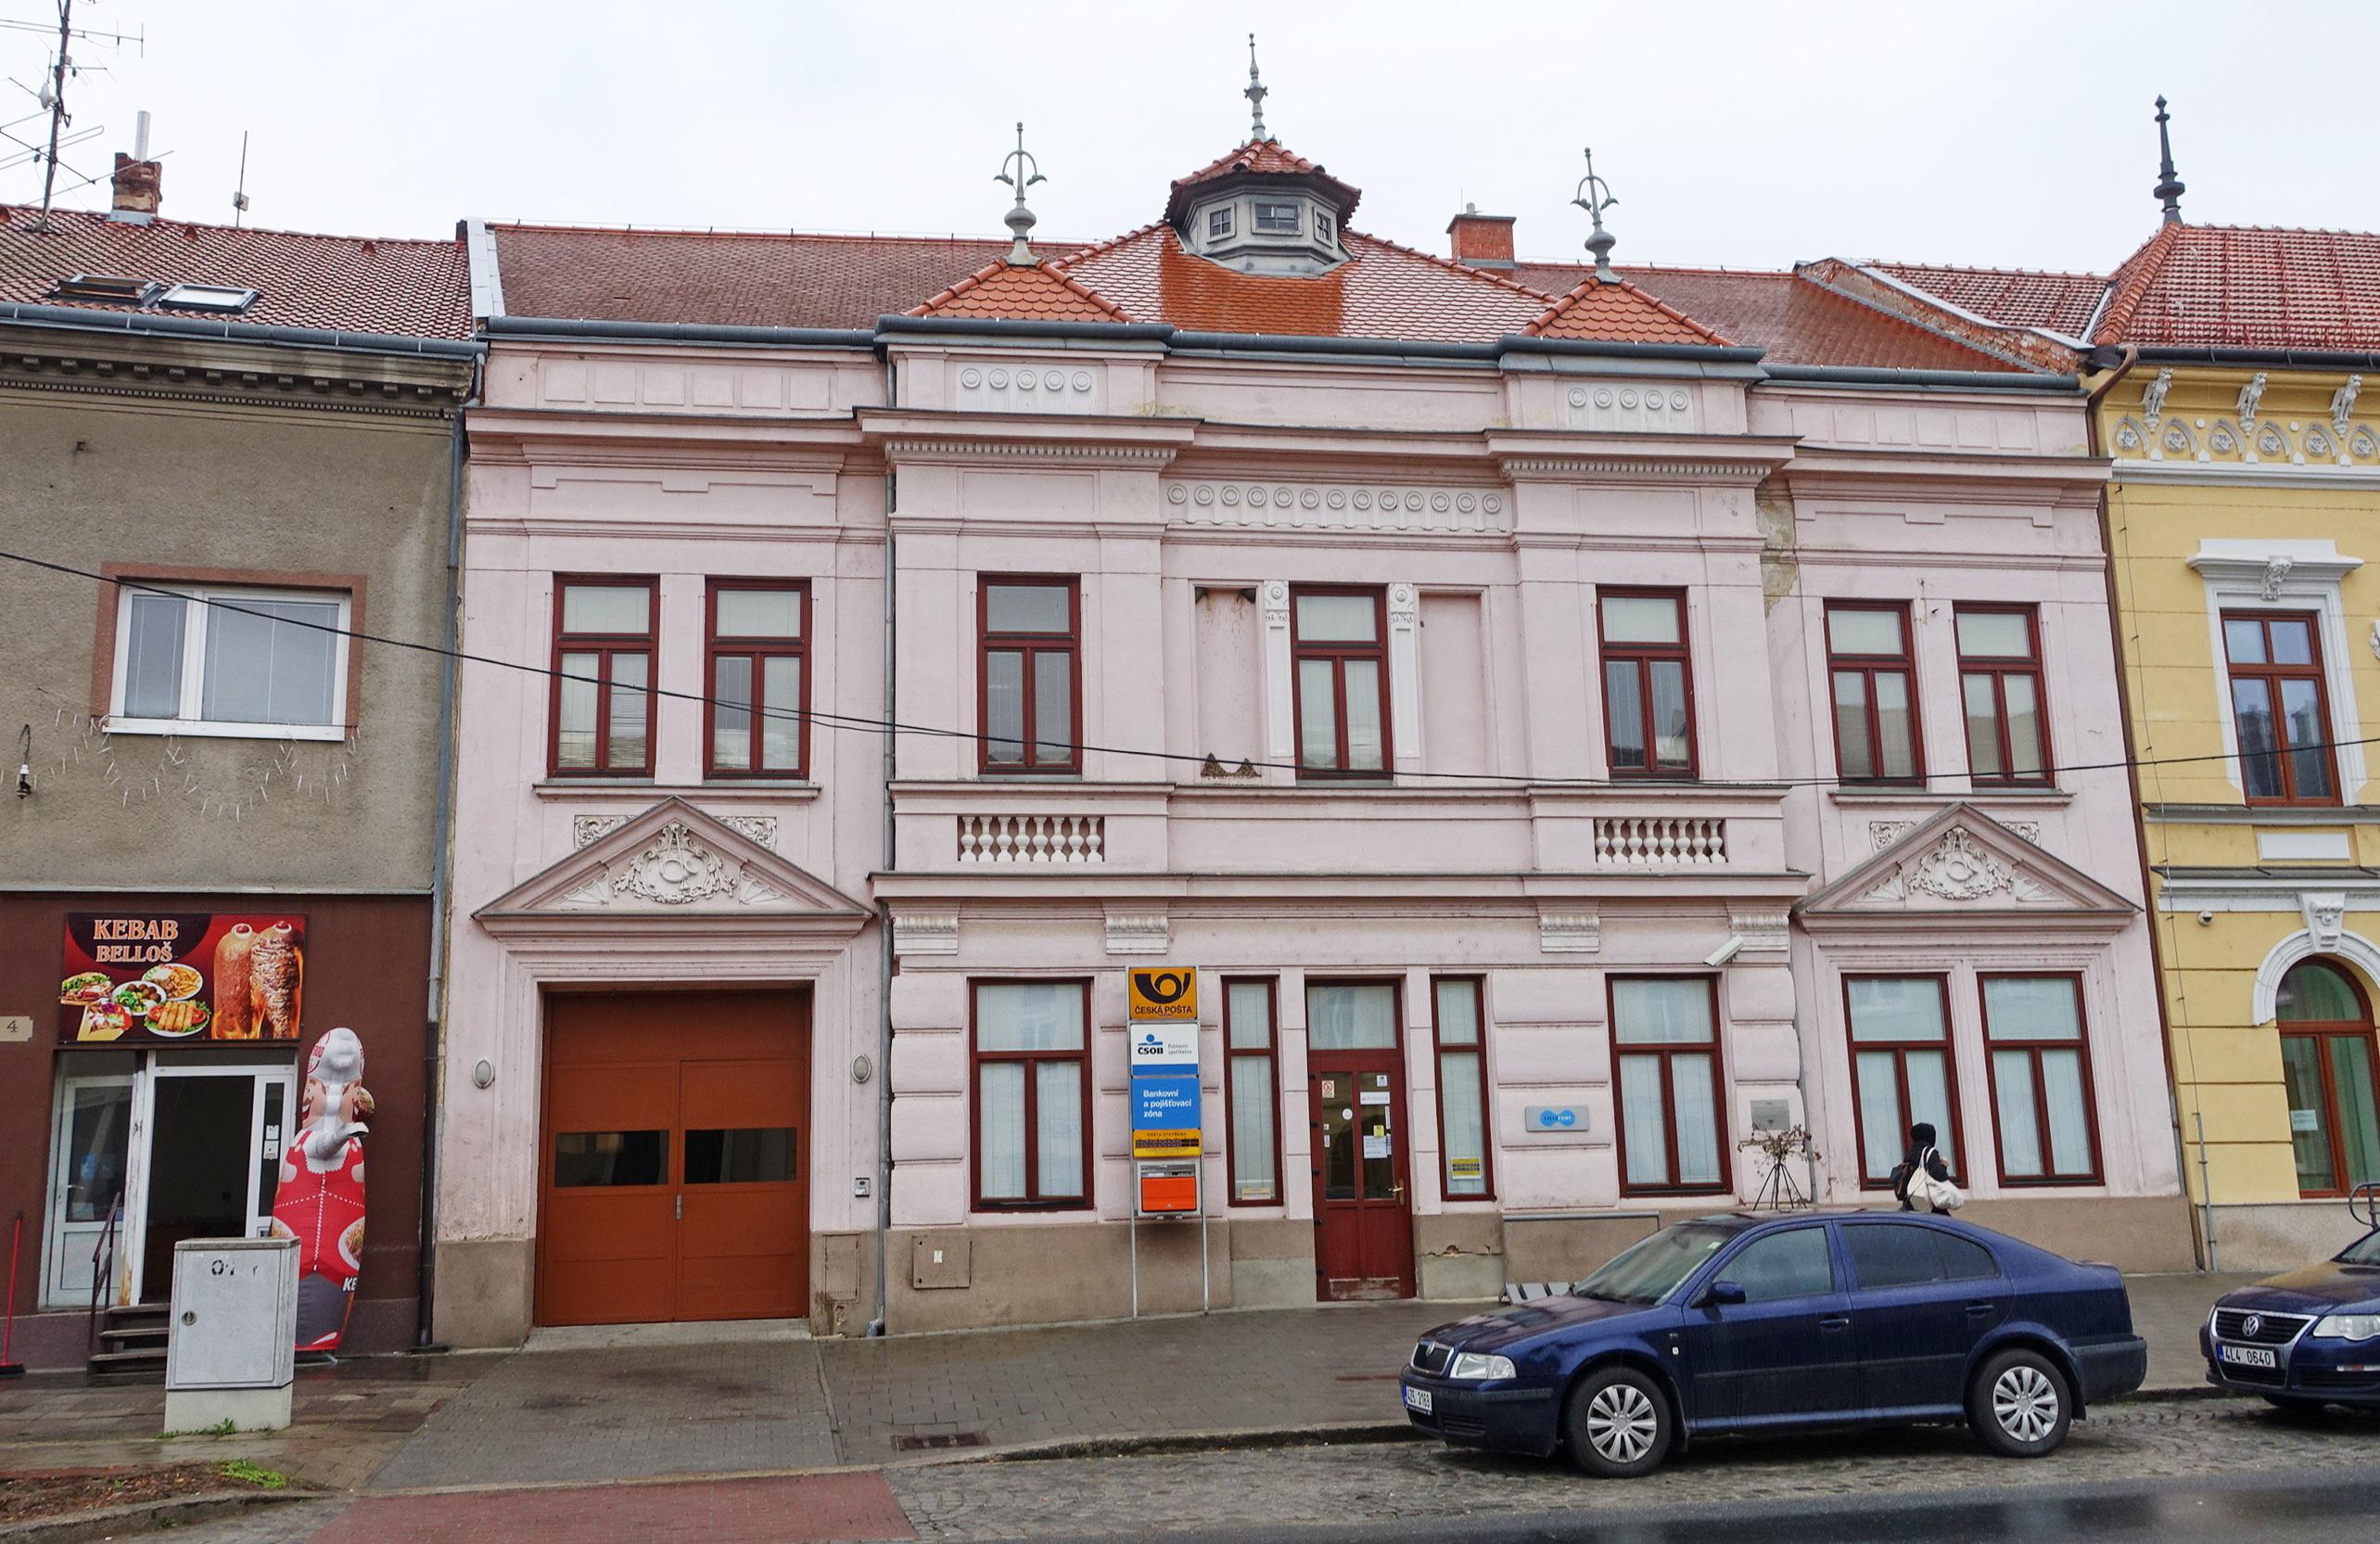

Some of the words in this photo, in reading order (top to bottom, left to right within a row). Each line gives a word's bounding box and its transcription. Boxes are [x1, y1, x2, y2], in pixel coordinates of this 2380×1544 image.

[94, 919, 179, 940] KEBAB
[95, 940, 173, 963] BELLOŠ
[1134, 1005, 1163, 1014] ČESKÁ
[1165, 1004, 1192, 1014] POŠTA
[6, 1019, 19, 1033] 4
[1138, 1046, 1164, 1054] ČSOB
[1143, 1090, 1178, 1098] Bankovní
[1150, 1099, 1192, 1109] pojišťovací
[2225, 1347, 2241, 1361] 4L4
[2246, 1350, 2272, 1365] 0640
